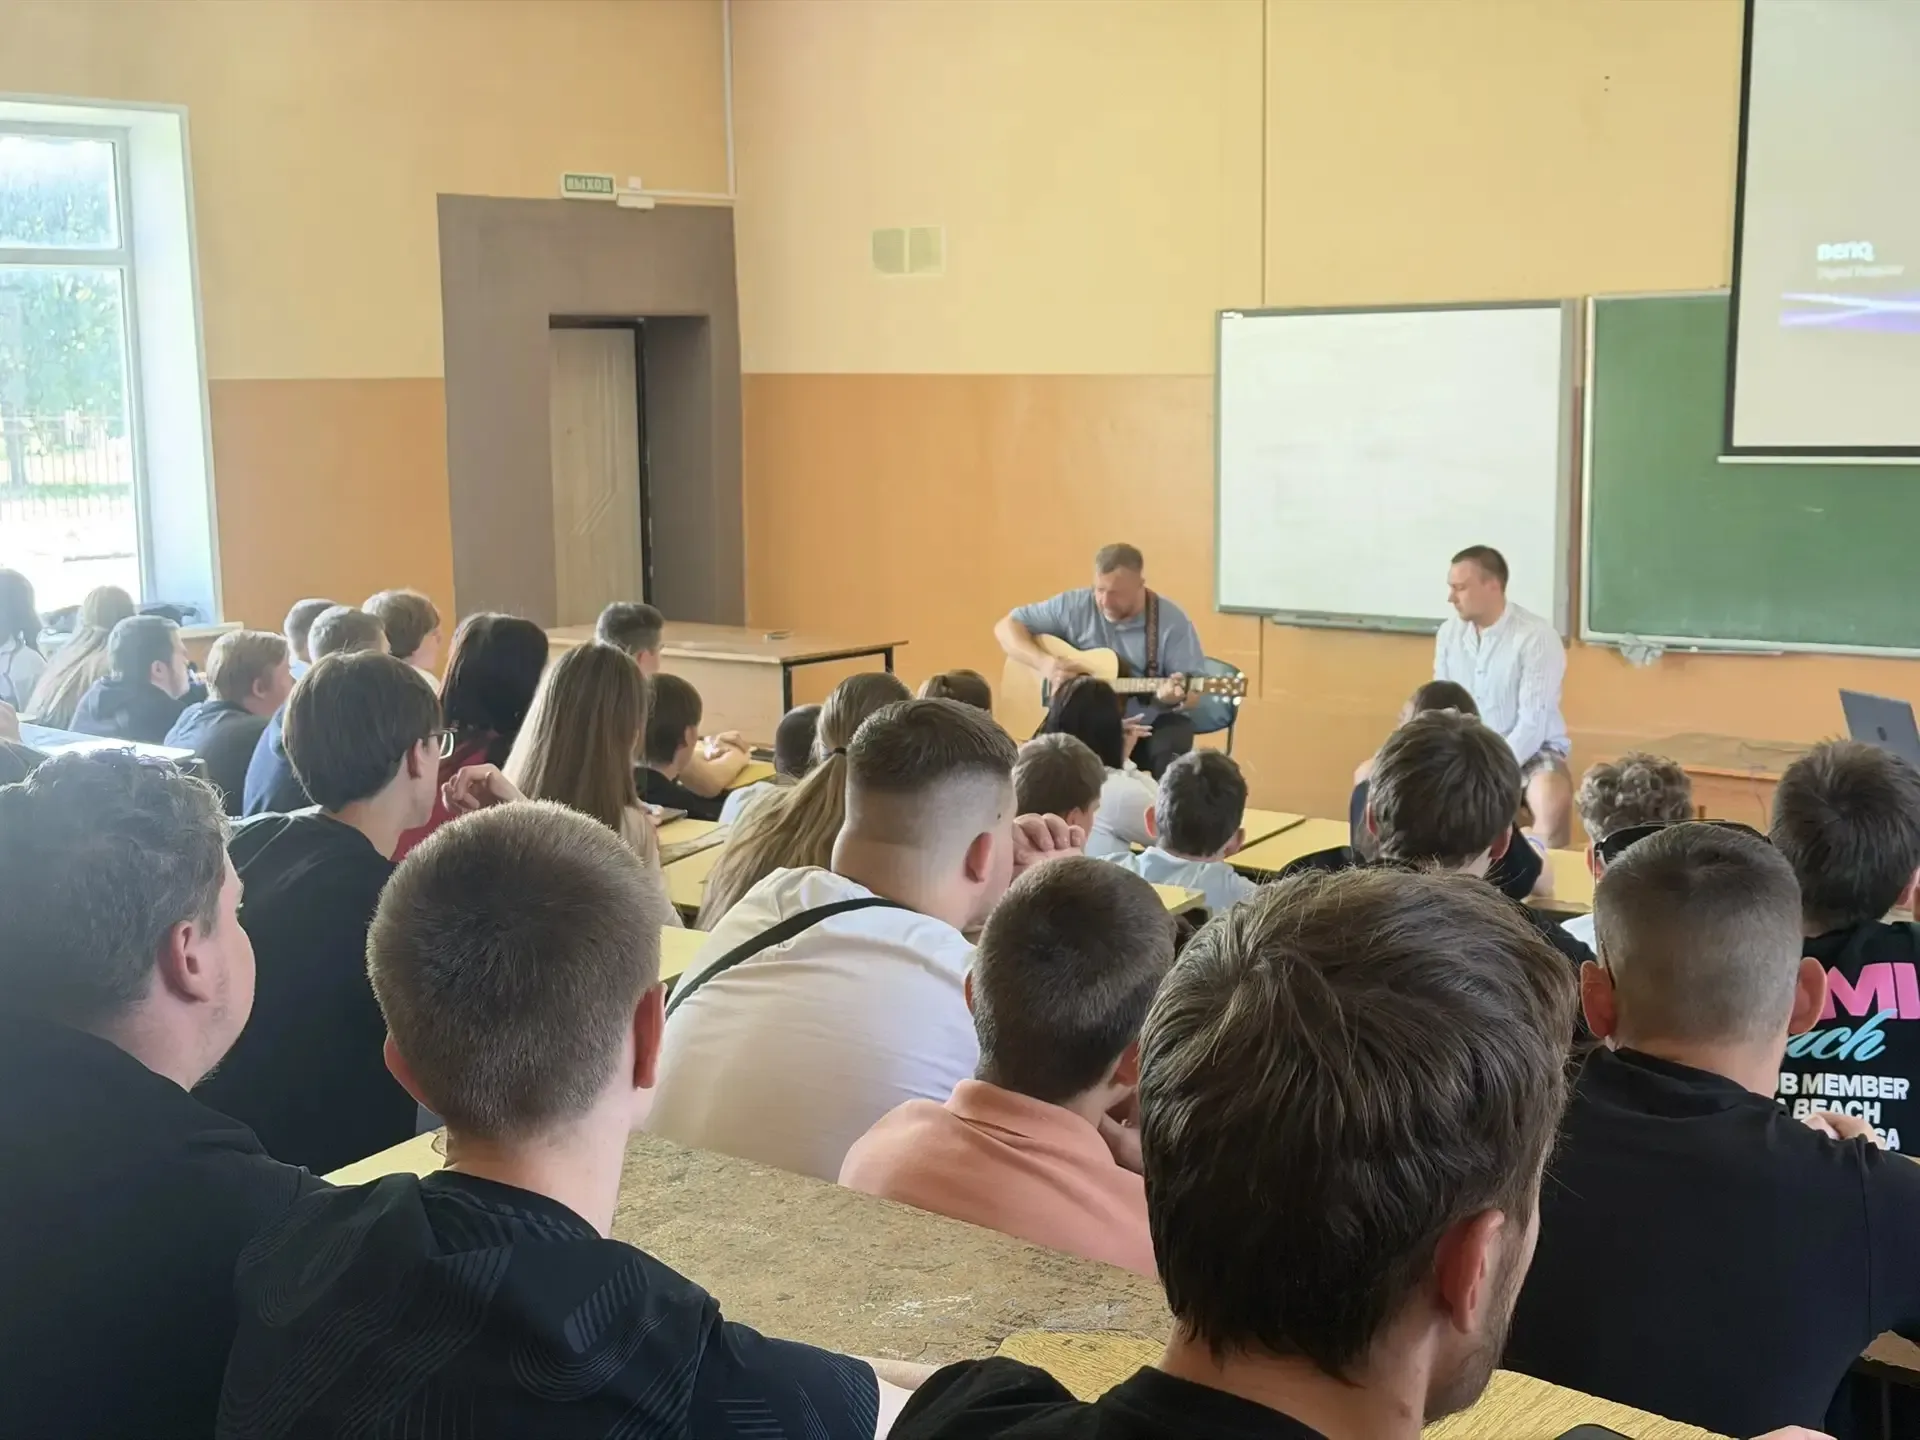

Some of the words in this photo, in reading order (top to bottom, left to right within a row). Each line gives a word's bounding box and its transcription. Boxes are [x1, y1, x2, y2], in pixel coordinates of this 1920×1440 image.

[1777, 1072, 1798, 1095] B
[1802, 1073, 1910, 1100] MEMBER
[1793, 1098, 1881, 1124] BEACH
